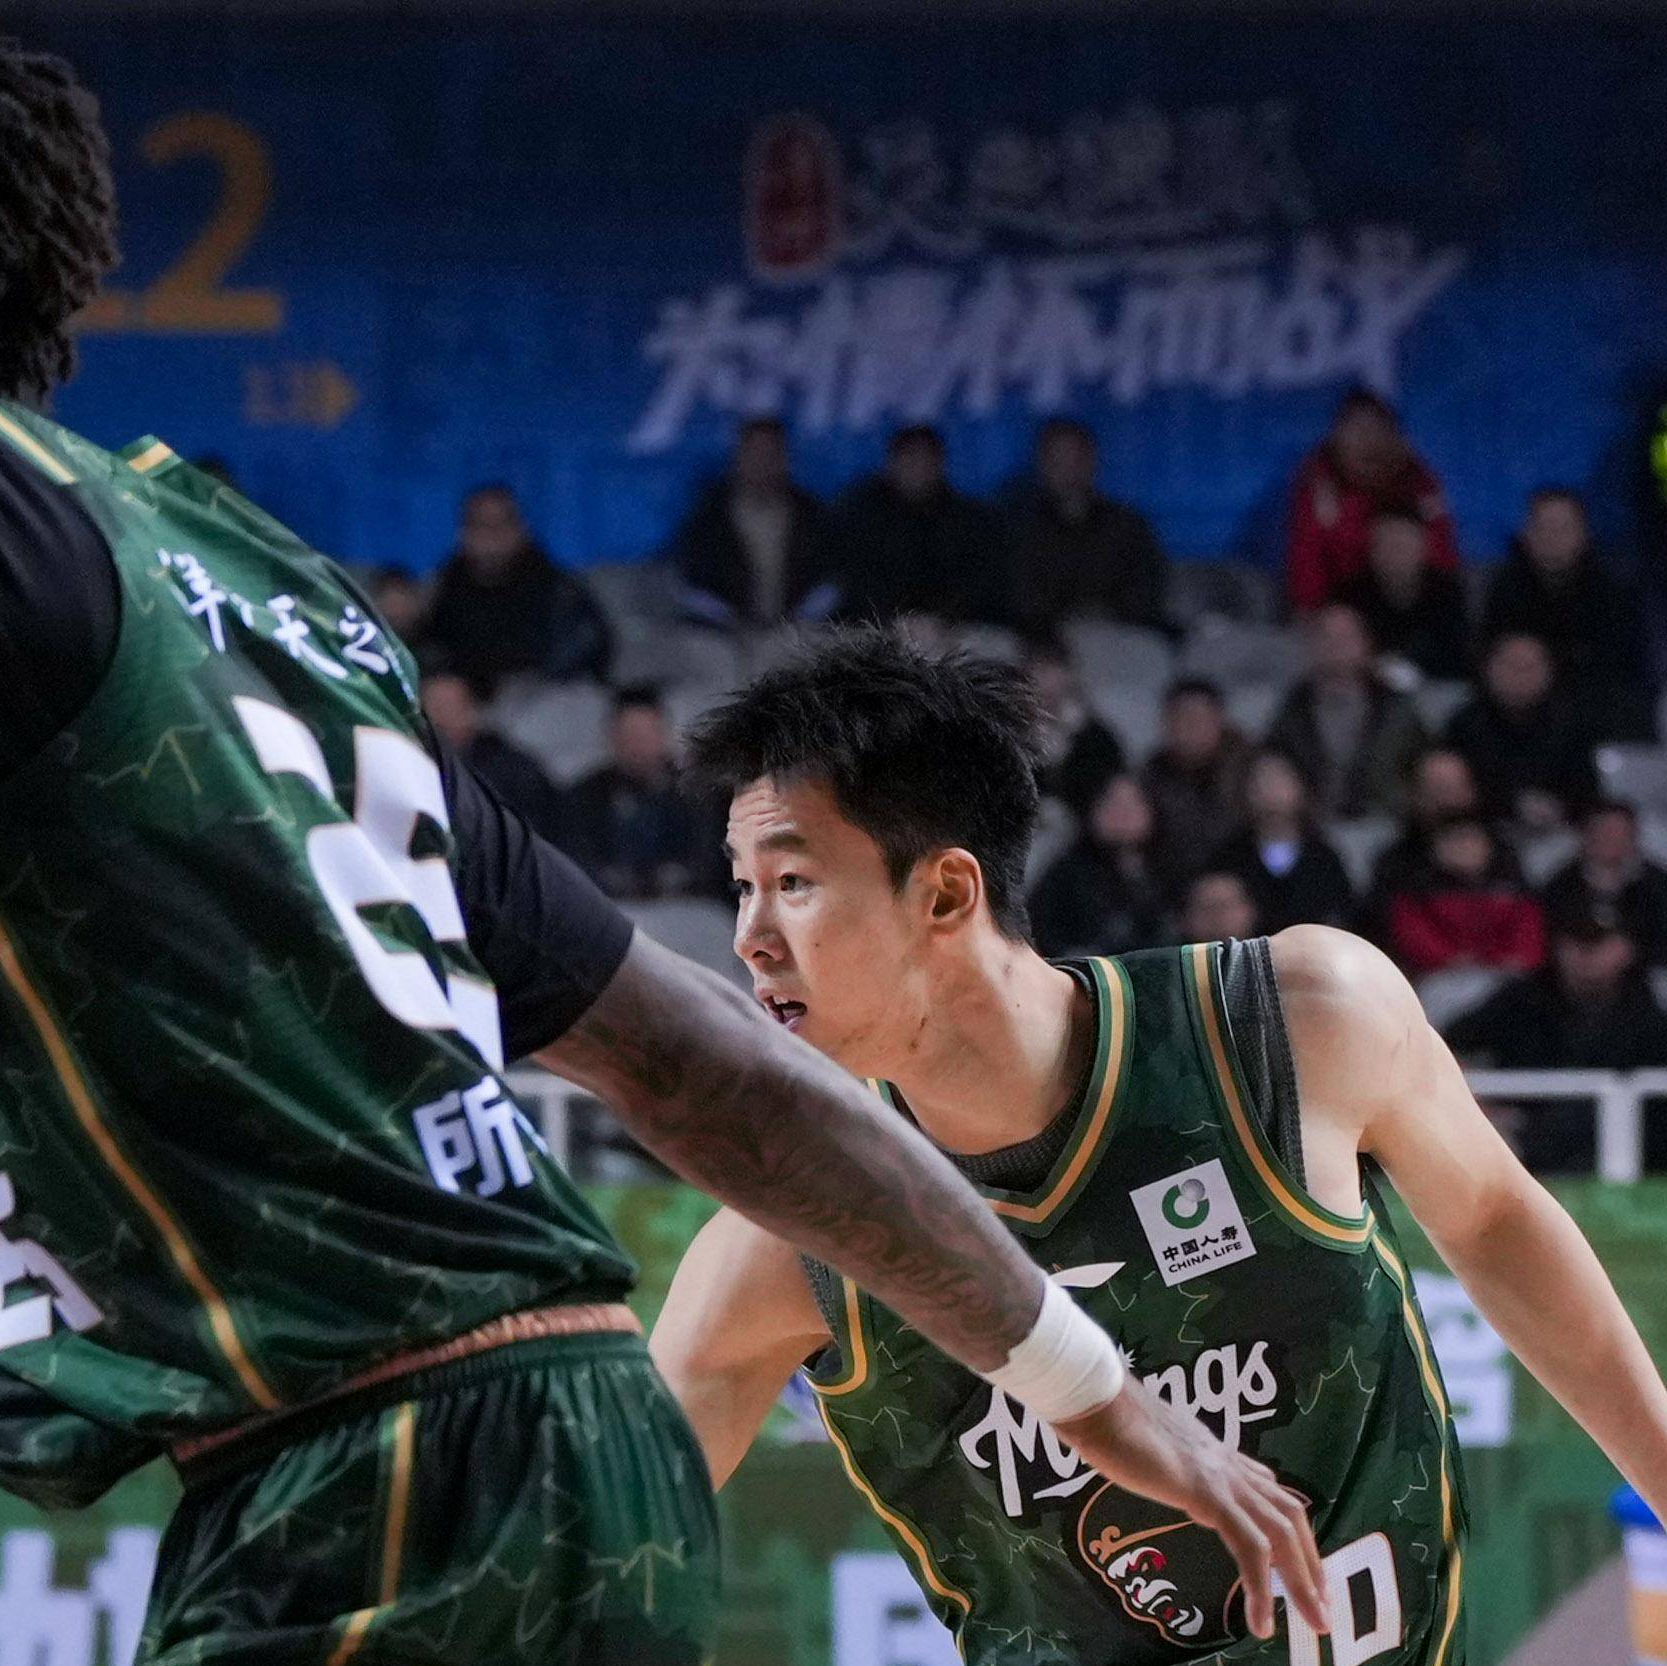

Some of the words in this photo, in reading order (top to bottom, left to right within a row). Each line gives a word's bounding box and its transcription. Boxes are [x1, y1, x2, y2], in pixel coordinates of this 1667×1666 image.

[65, 108, 286, 333] 2
[1162, 1225, 1238, 1262] 中国人寿
[1168, 1252, 1211, 1274] CHINA
[1214, 1241, 1243, 1258] LIFE
